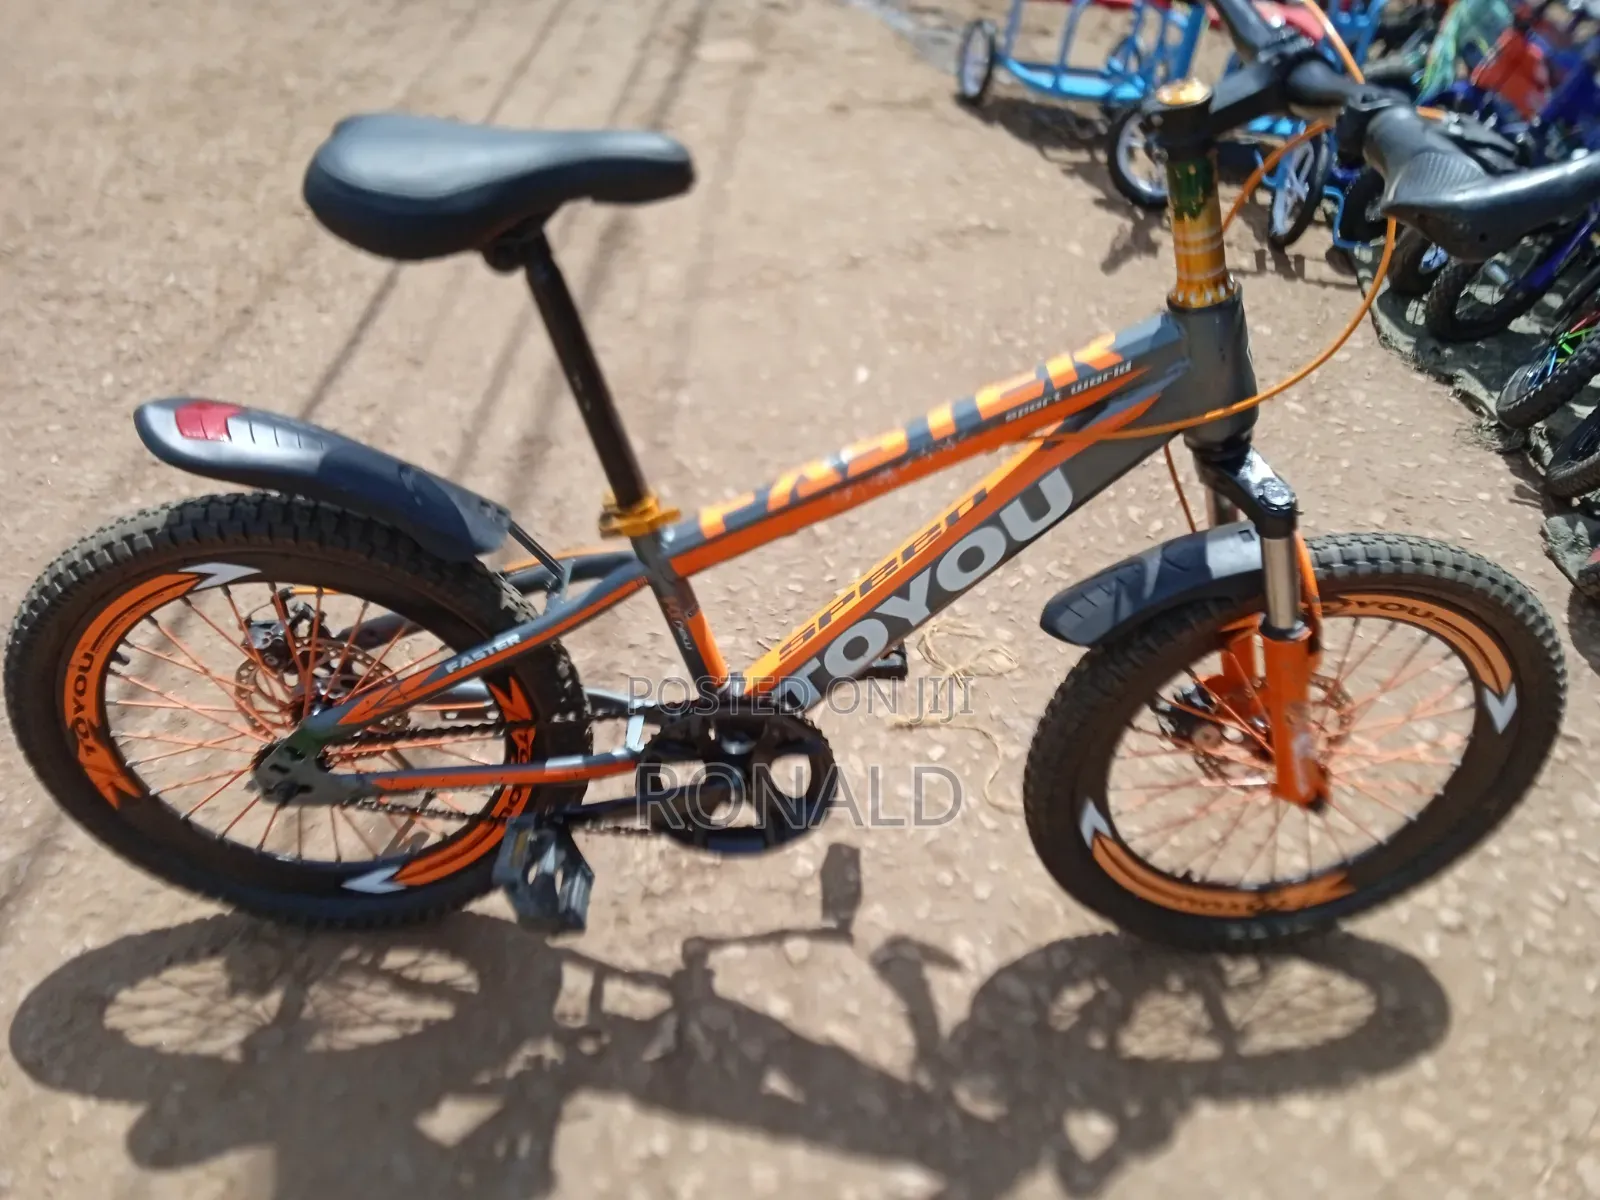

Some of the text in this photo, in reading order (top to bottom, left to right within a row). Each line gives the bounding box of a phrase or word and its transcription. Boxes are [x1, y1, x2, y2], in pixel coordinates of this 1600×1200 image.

[773, 468, 1073, 711] TOYOU
[72, 652, 97, 757] TOYOU
[446, 633, 521, 674] FASTER
